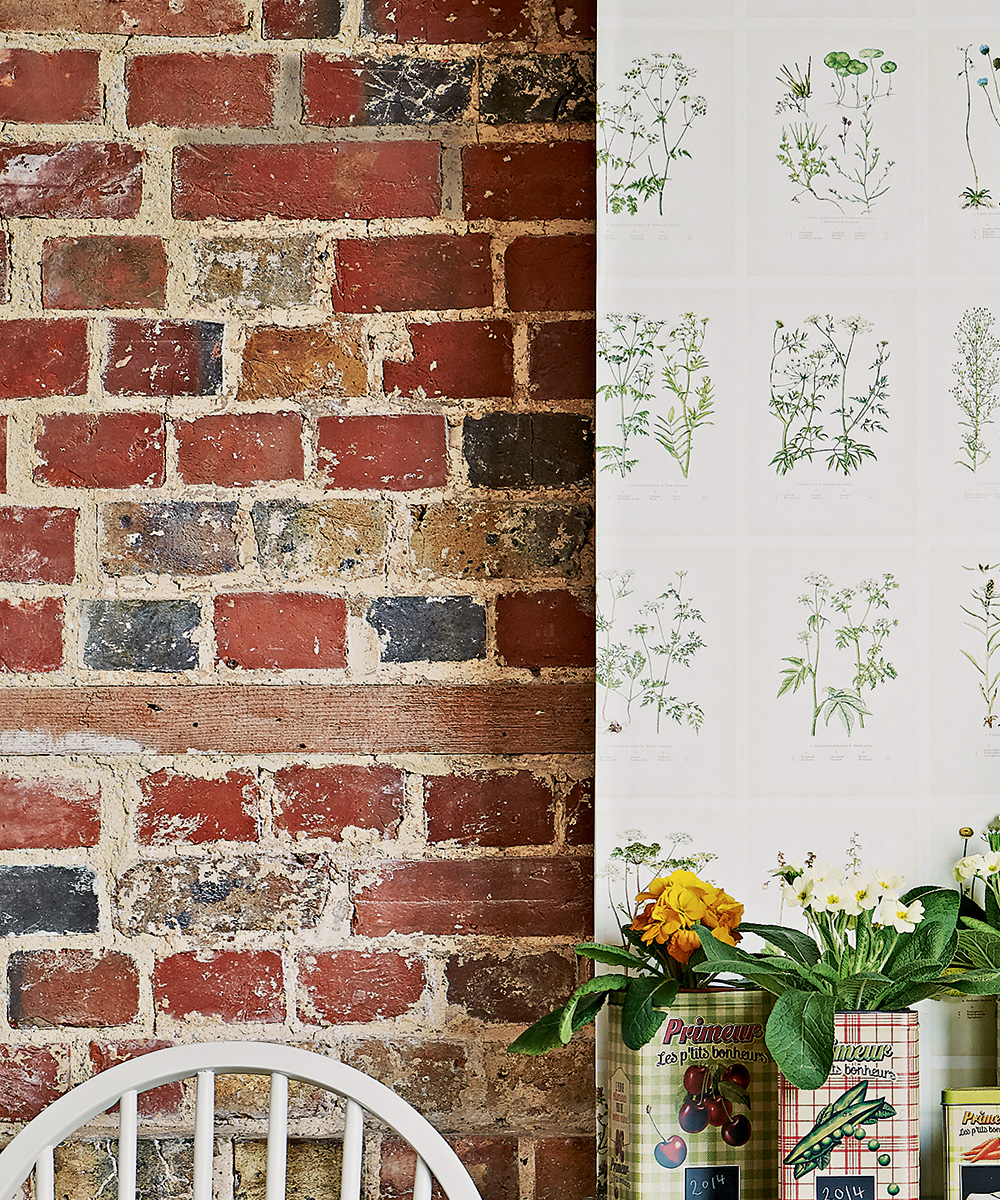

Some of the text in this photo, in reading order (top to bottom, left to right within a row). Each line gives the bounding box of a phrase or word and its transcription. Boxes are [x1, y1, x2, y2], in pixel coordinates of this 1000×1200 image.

[662, 1016, 764, 1045] Primeur
[656, 1045, 768, 1067] Les p'tits bonheurs
[845, 1063, 896, 1080] bonheurs
[690, 1174, 726, 1196] 2014
